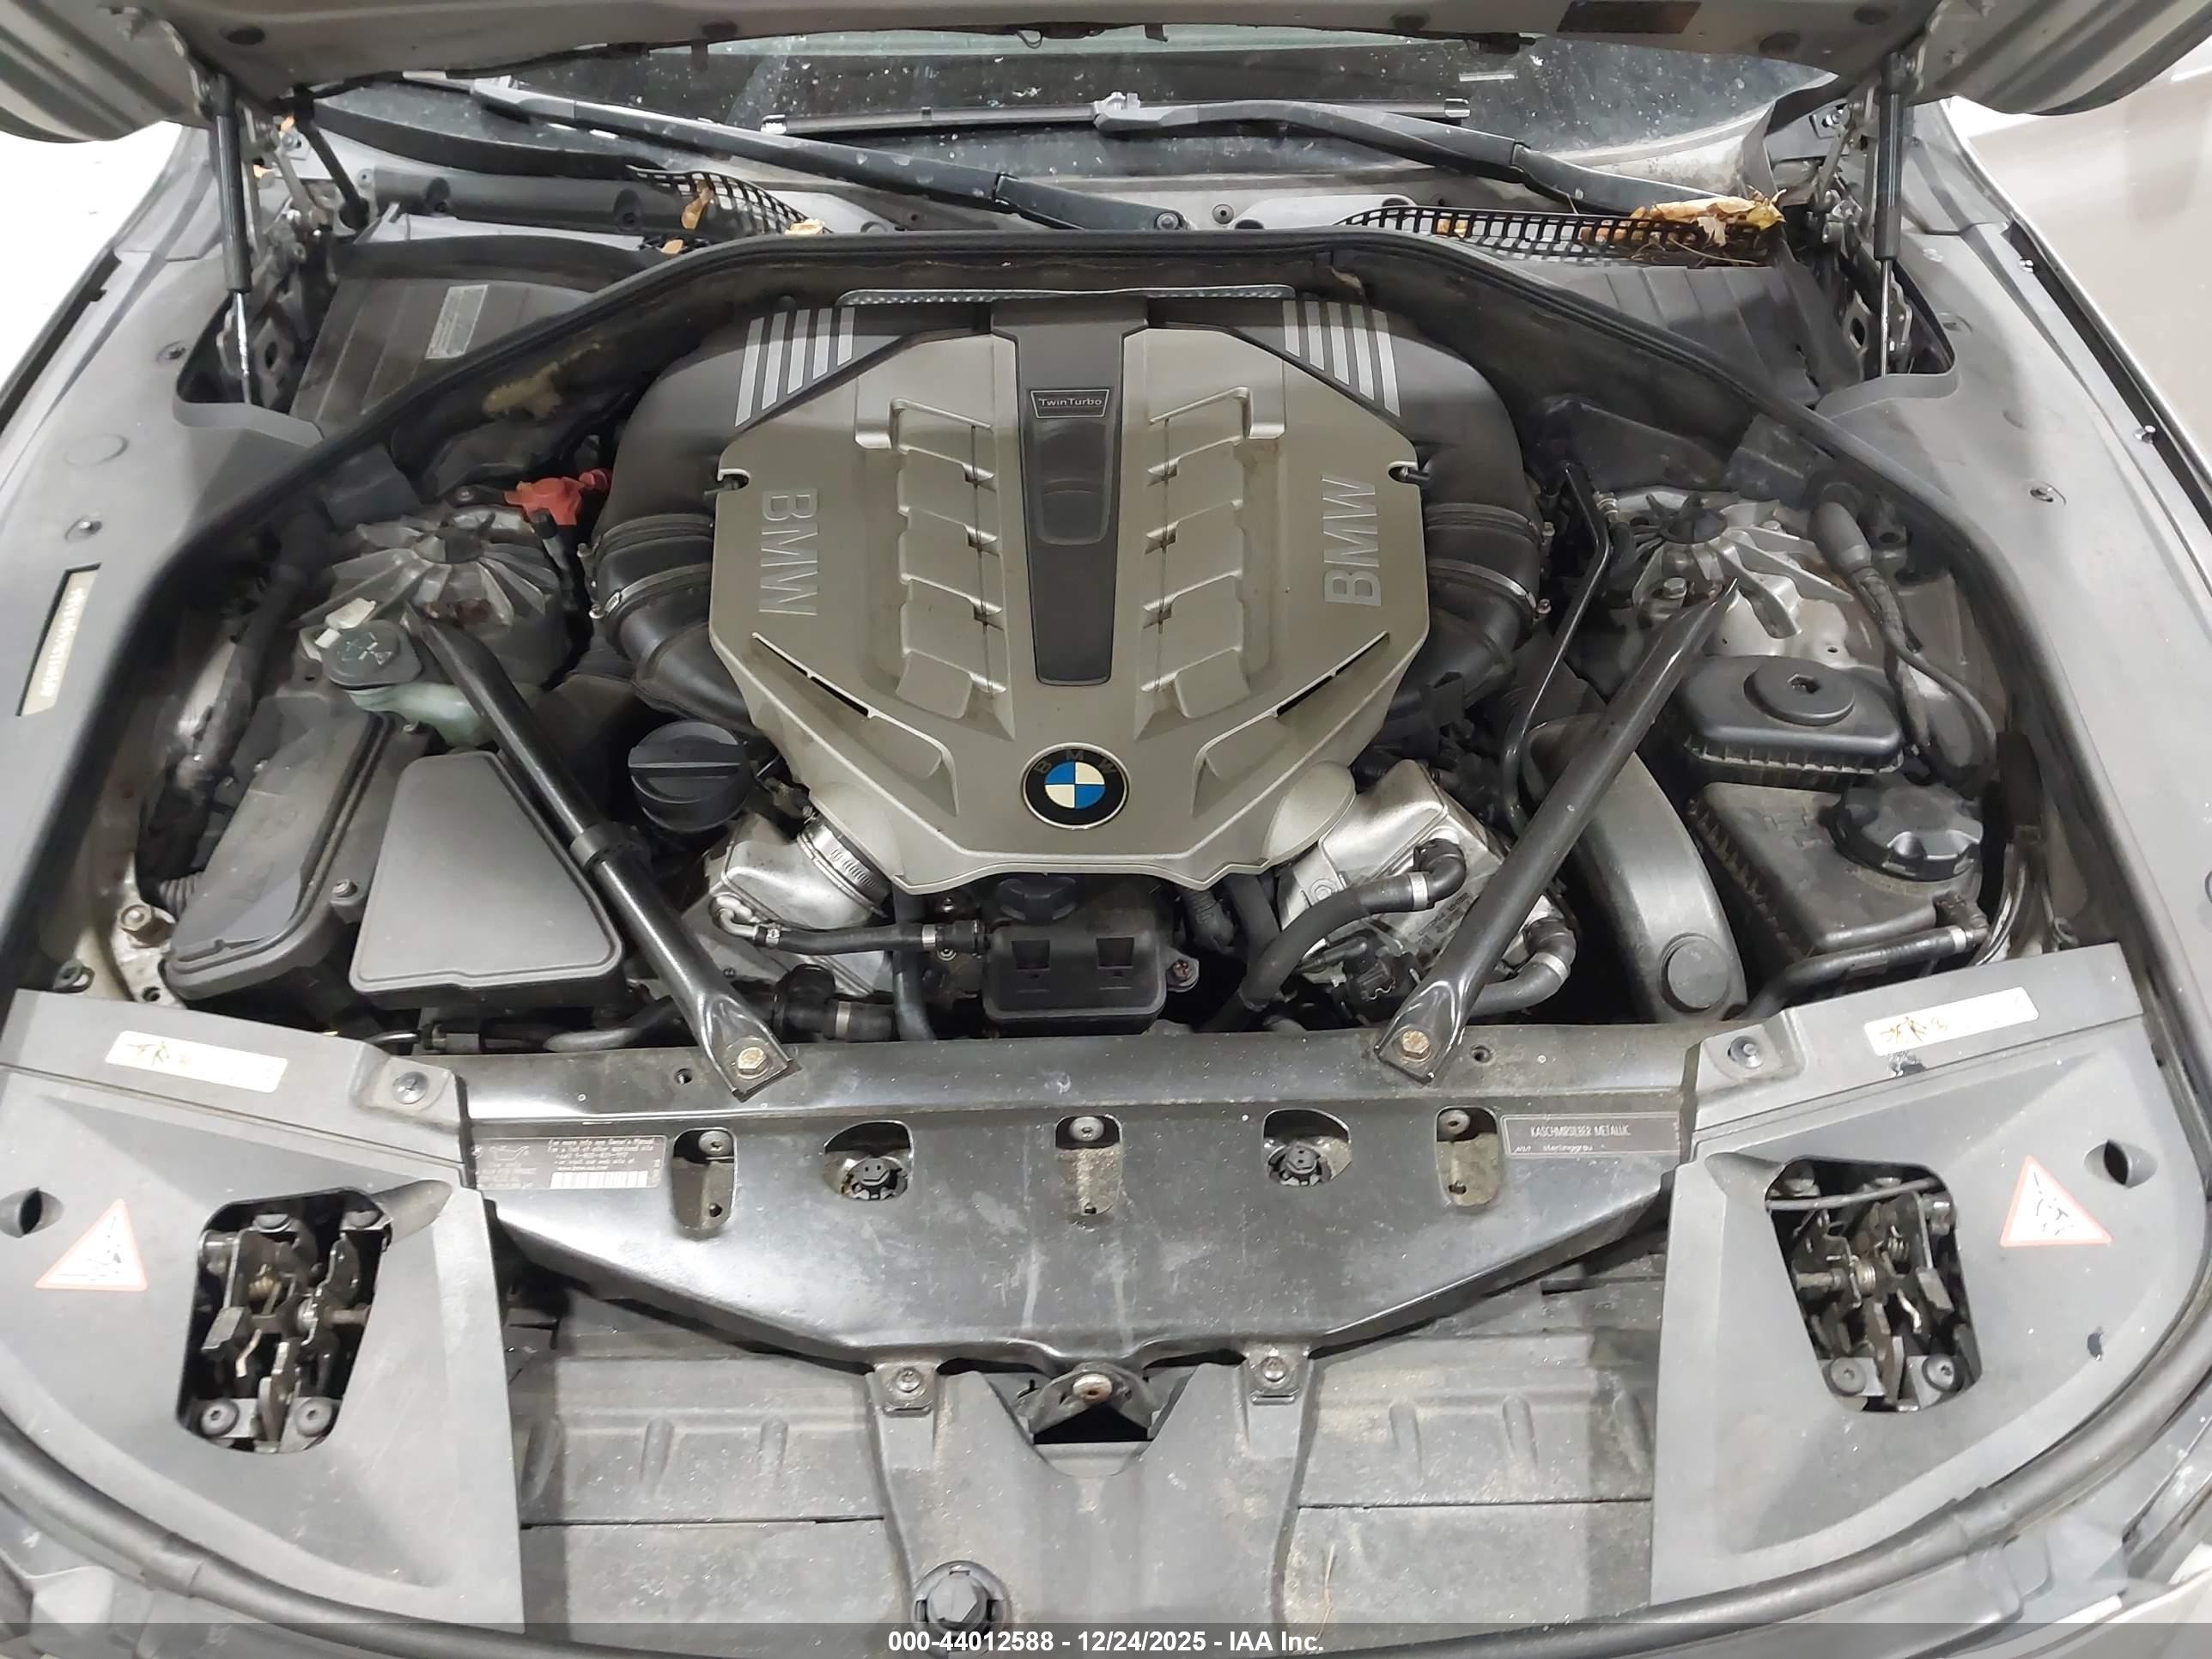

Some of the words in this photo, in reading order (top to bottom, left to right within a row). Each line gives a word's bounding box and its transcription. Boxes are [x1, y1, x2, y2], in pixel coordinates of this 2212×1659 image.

[1038, 398, 1103, 407] TwinTurbo
[759, 487, 818, 616] BMW
[1321, 474, 1382, 606] BMW
[1033, 749, 1117, 775] BMW
